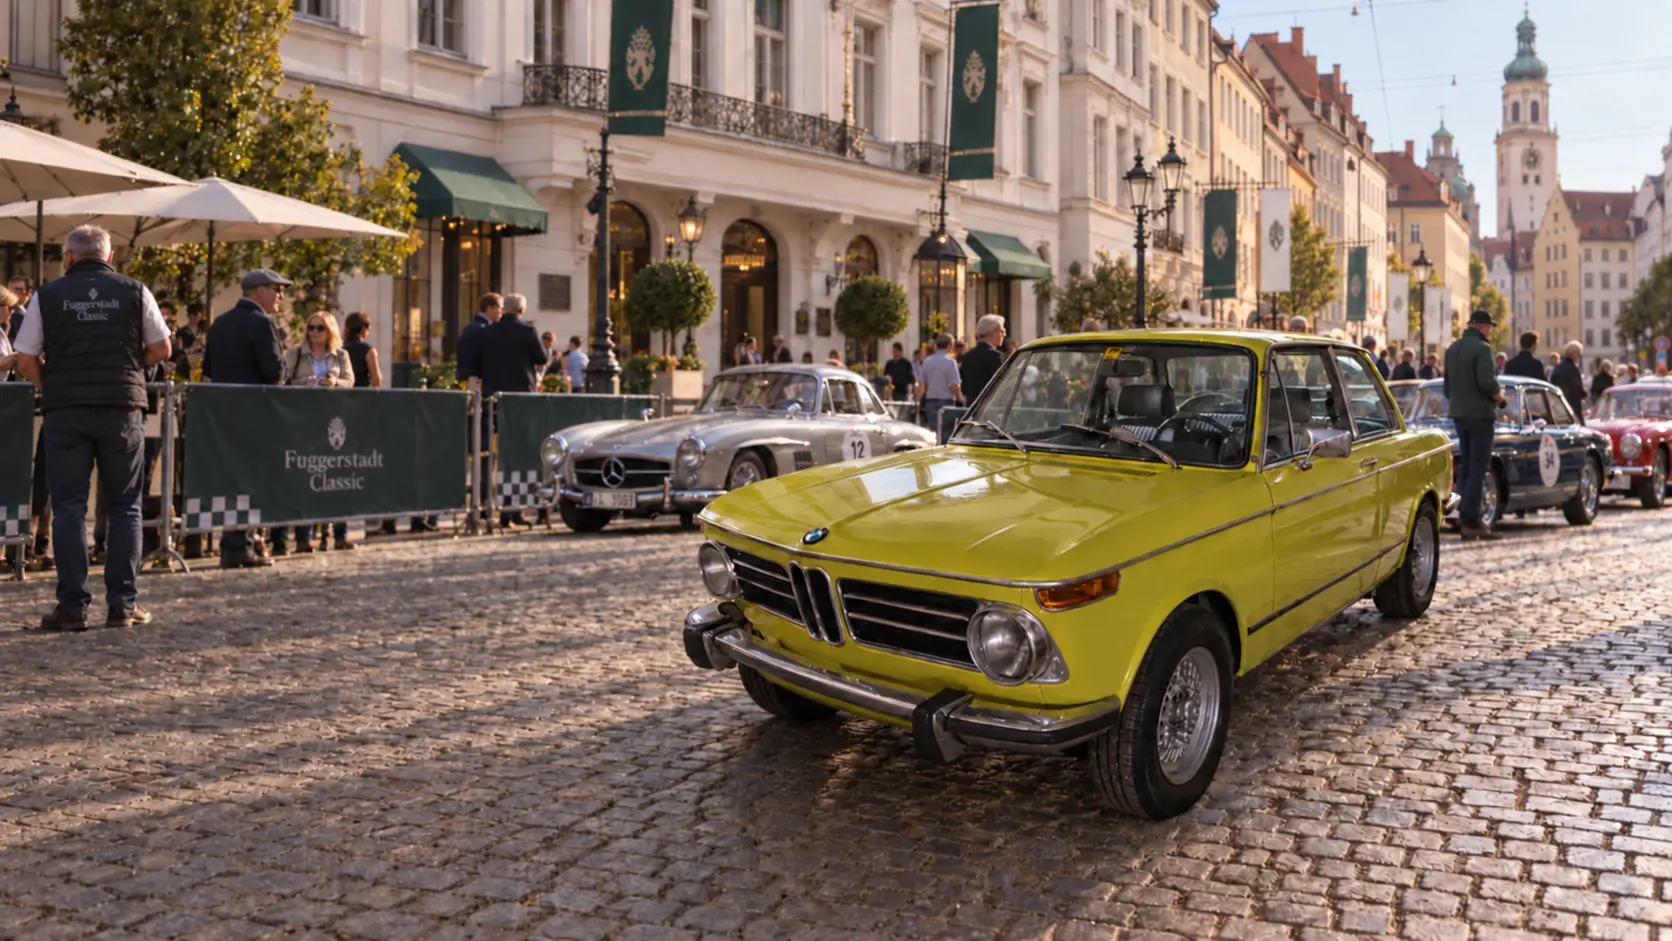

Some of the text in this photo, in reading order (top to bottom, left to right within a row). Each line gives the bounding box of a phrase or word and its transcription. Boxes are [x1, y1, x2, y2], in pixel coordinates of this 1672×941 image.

[850, 440, 864, 460] 12
[285, 449, 384, 473] Fuggerstadt
[310, 473, 365, 492] Classic
